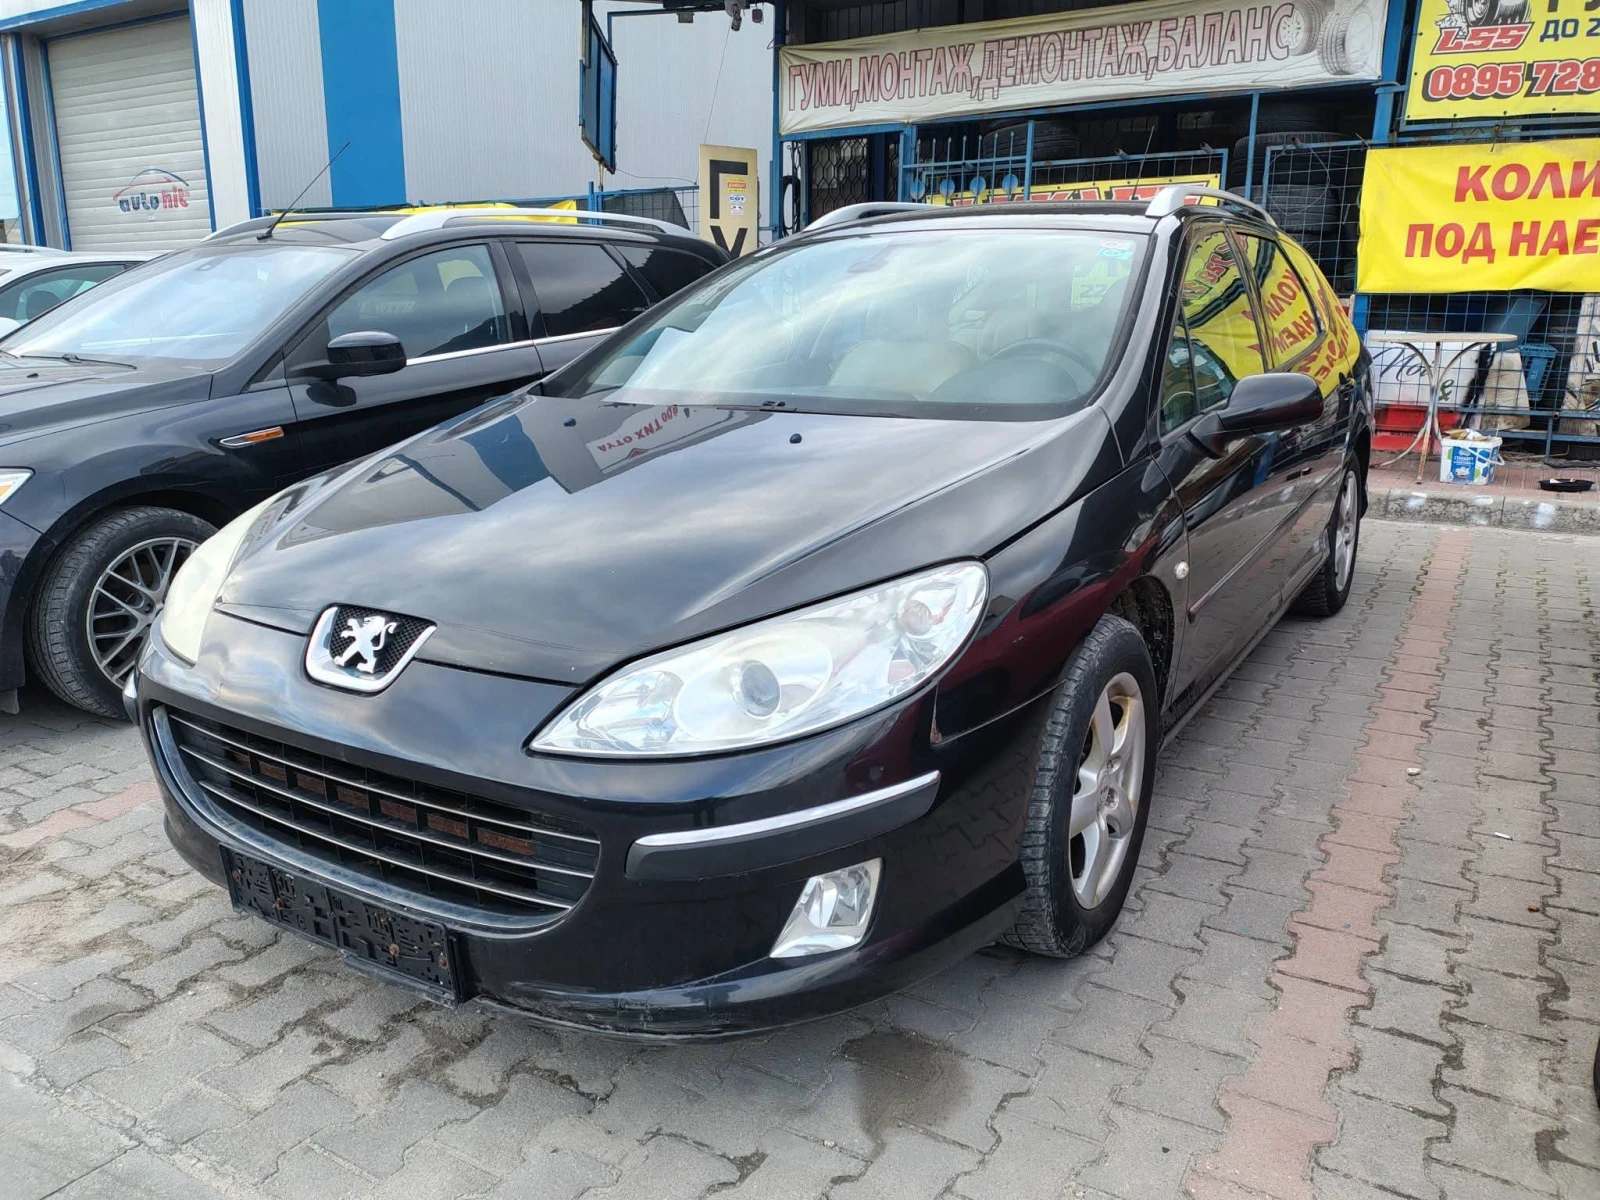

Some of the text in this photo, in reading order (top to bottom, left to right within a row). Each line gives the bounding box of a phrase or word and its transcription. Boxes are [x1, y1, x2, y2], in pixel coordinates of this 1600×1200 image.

[1539, 18, 1579, 43] ДО
[1423, 64, 1526, 101] 0895
[1404, 222, 1496, 264] ПОД
